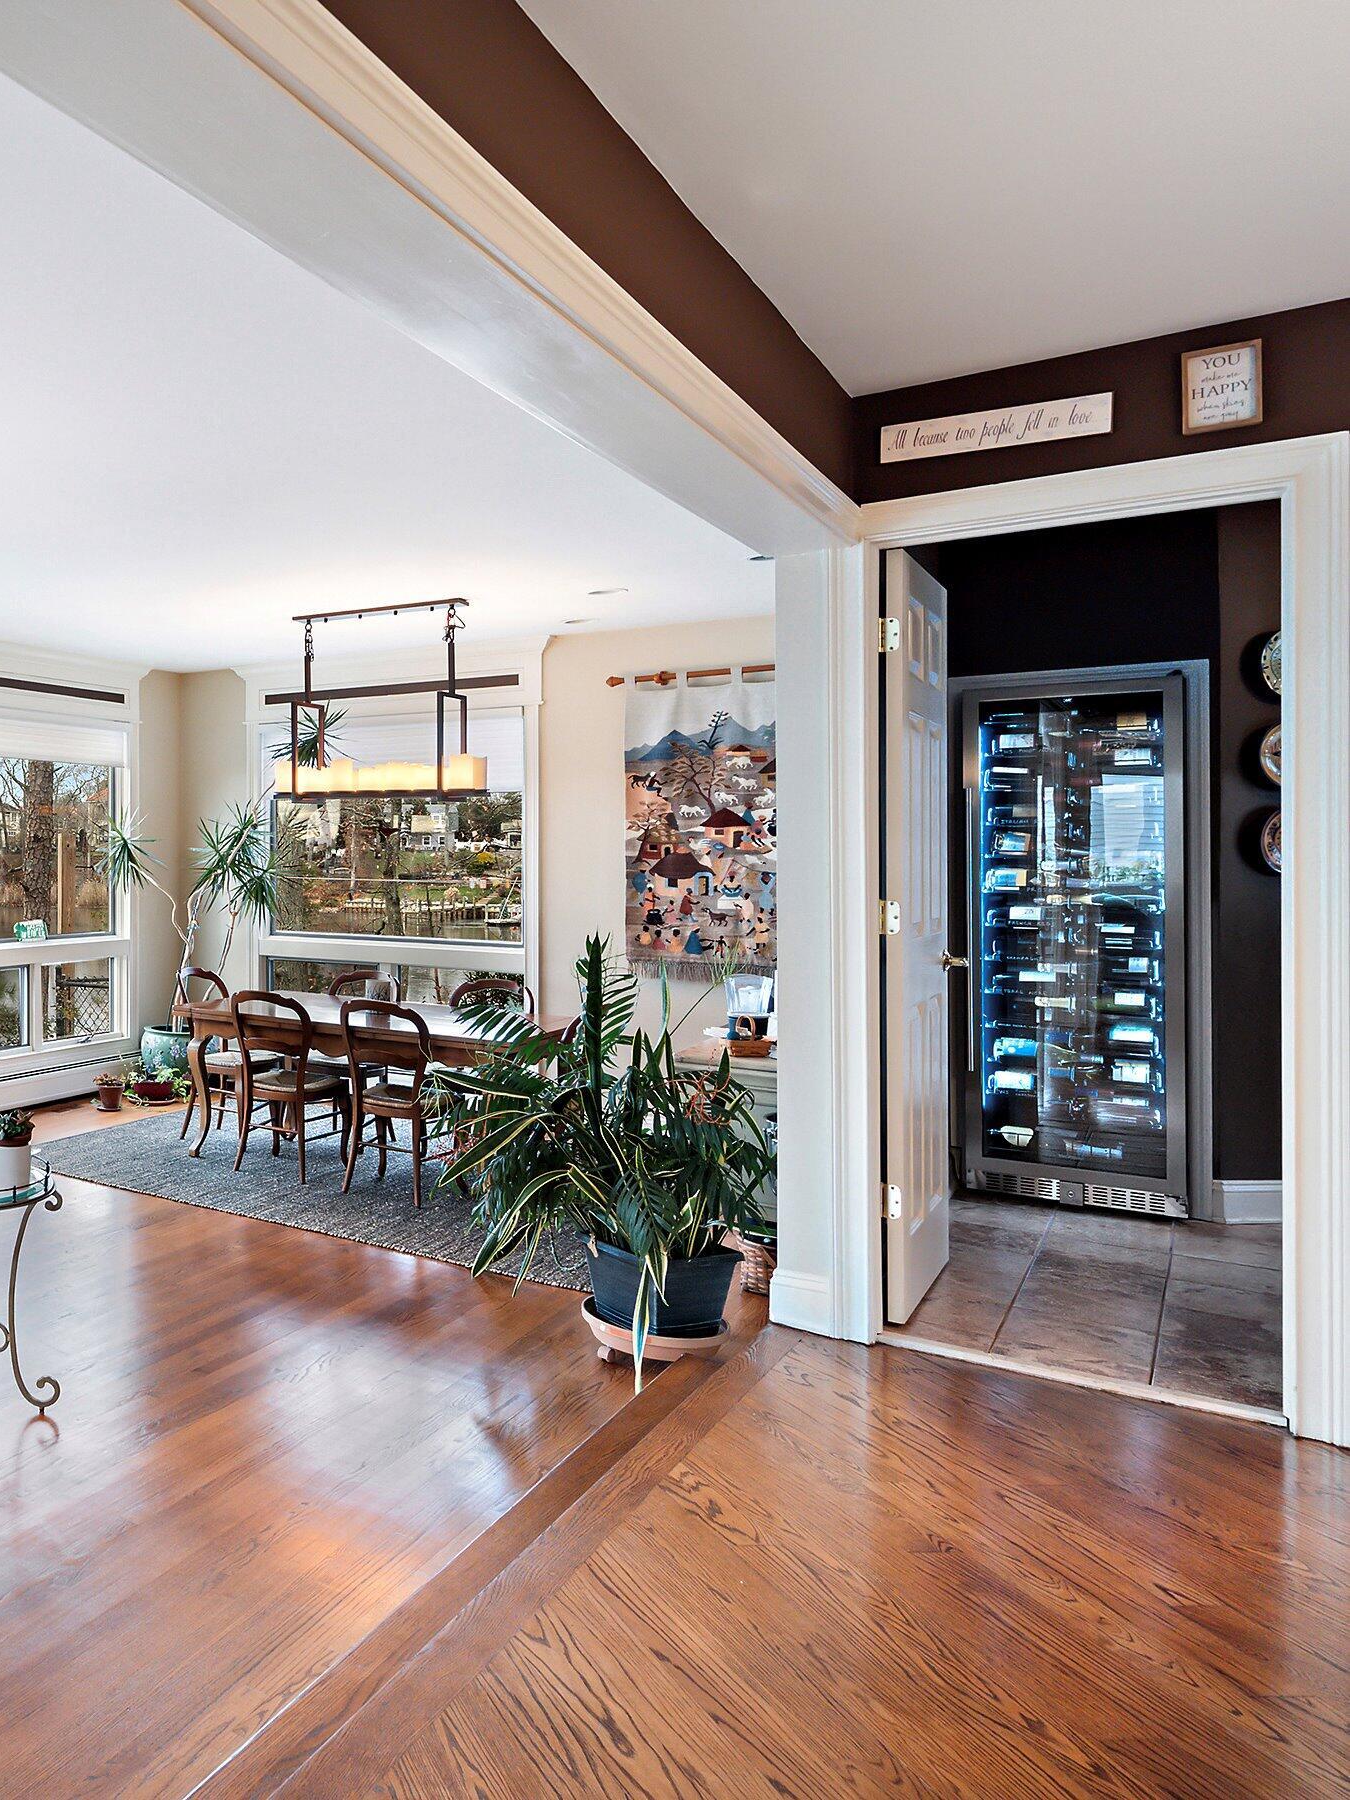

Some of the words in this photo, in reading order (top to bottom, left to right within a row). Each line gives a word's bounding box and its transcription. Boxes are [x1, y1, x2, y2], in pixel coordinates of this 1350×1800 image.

[1201, 353, 1241, 370] YOU
[1191, 378, 1252, 400] HAPPY
[887, 429, 908, 451] All
[913, 427, 949, 448] because
[955, 427, 976, 441] two
[978, 414, 1015, 447] people
[1016, 408, 1044, 440] fell
[1048, 413, 1059, 428] in
[1068, 403, 1093, 426] love
